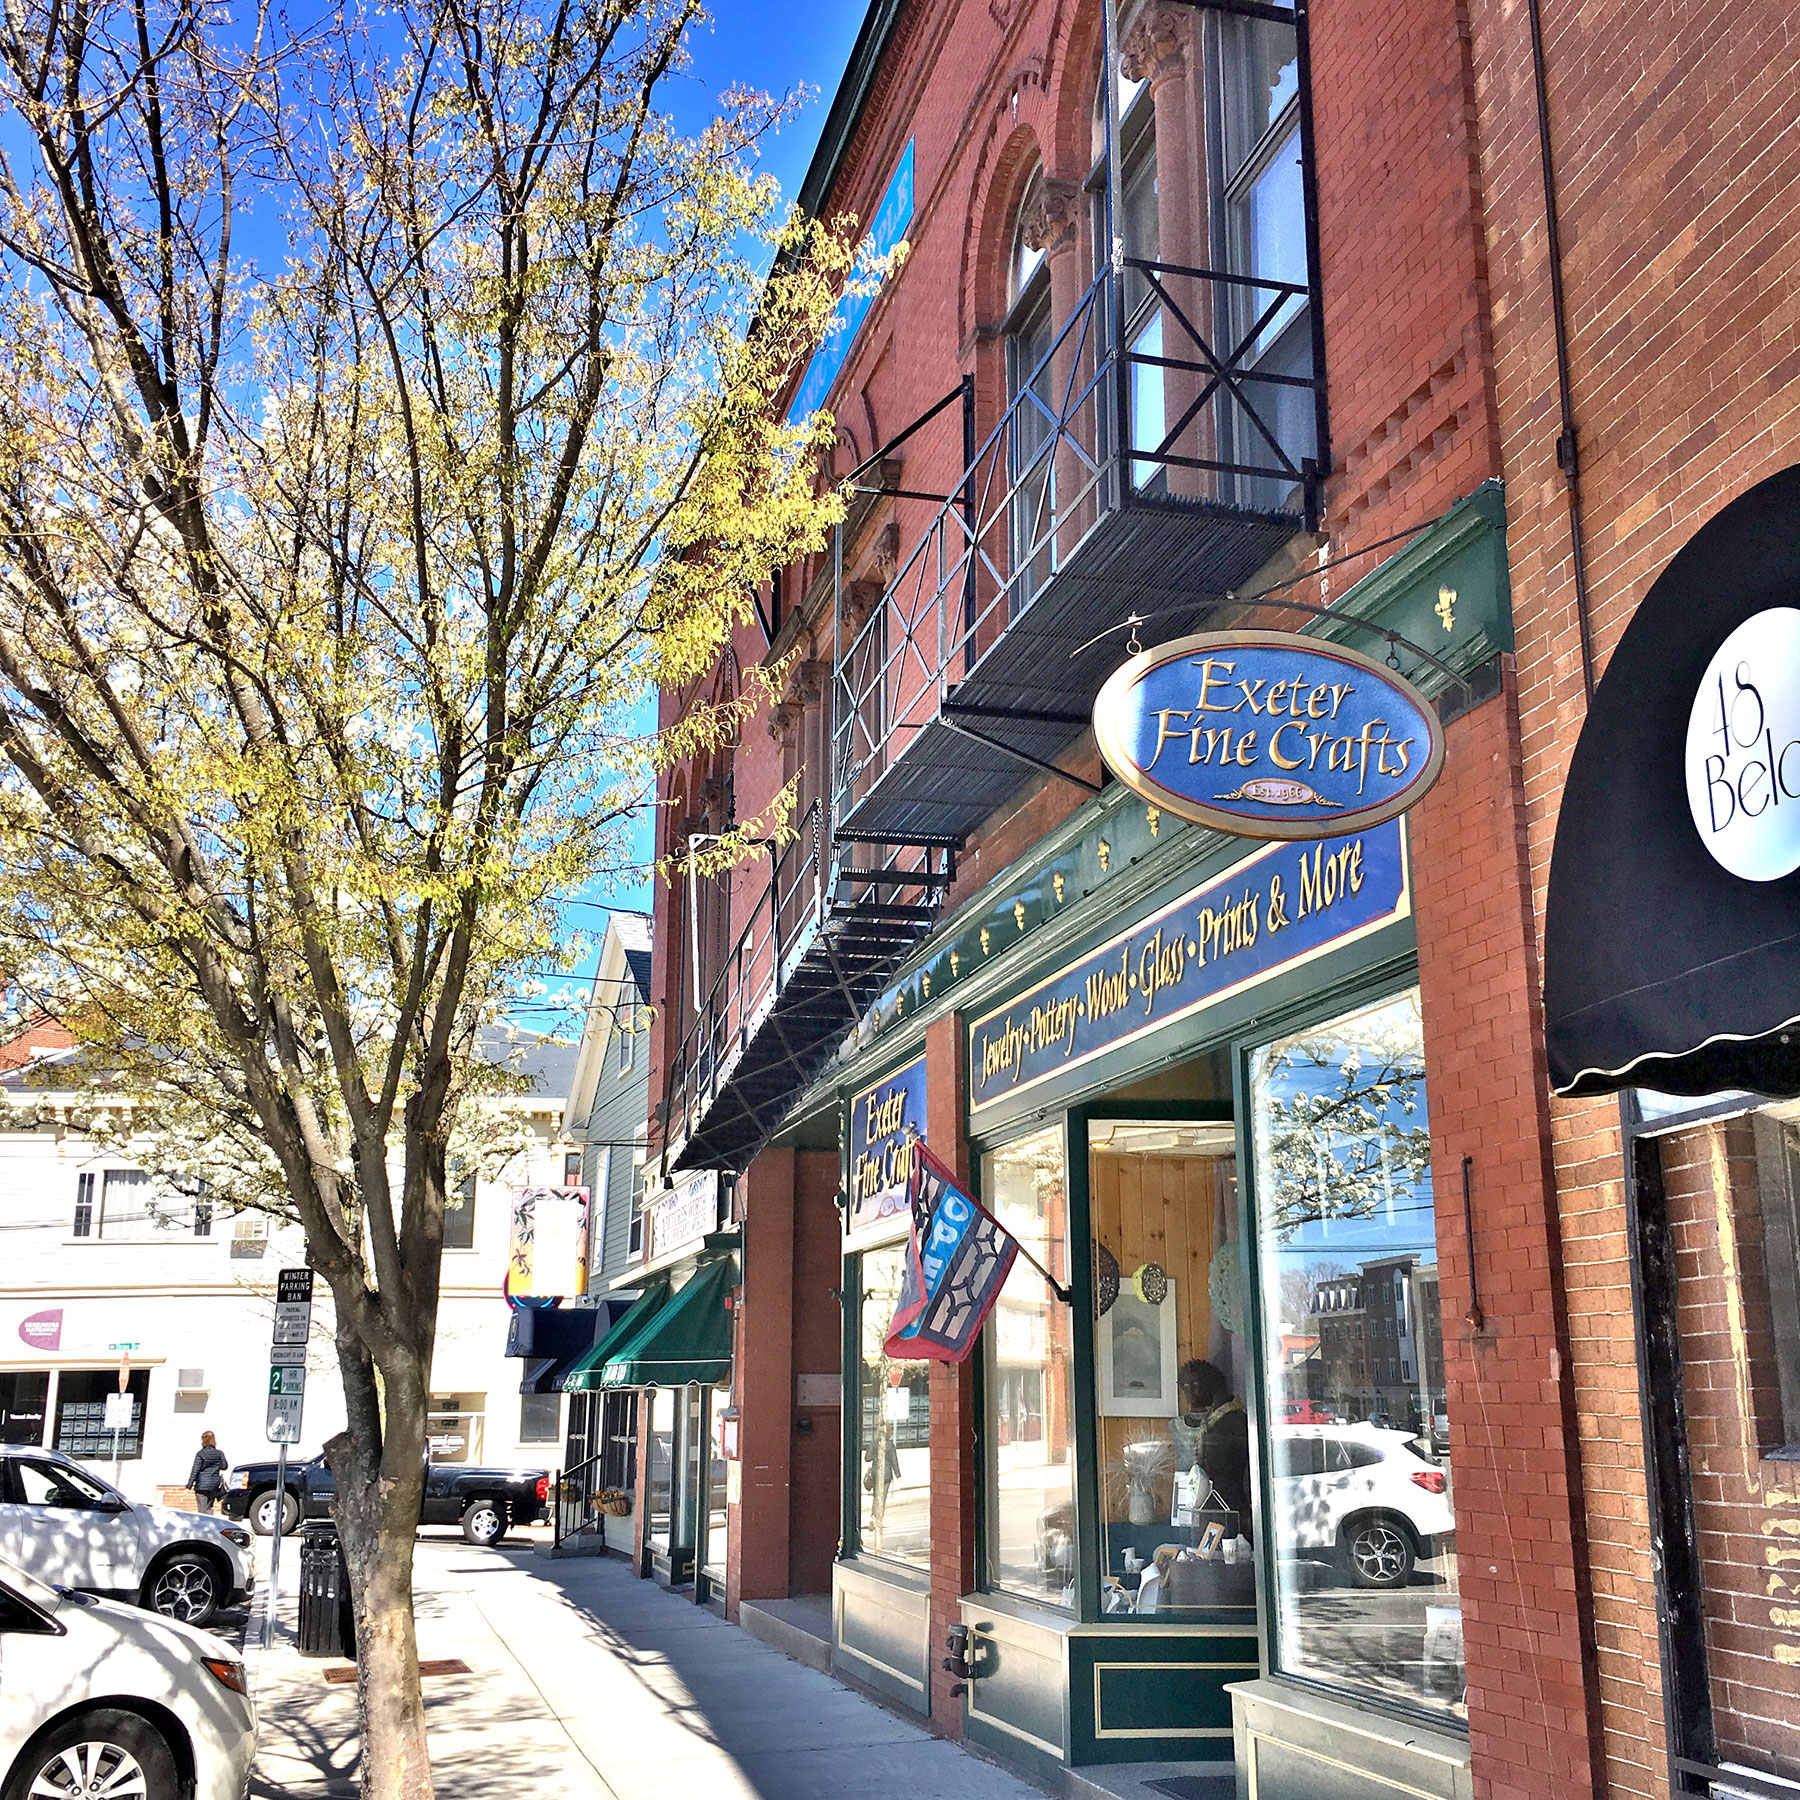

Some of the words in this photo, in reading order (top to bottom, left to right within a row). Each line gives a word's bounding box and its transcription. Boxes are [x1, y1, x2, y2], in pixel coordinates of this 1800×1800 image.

[1191, 658, 1356, 719] Exeter
[1713, 661, 1764, 756] 48
[1145, 708, 1259, 772] Fine
[1268, 718, 1415, 795] Crafts
[1251, 784, 1275, 798] Est.
[1275, 786, 1303, 800] 1966
[1085, 947, 1129, 1025] Wood
[1138, 927, 1186, 1016] Glass
[1198, 888, 1260, 968] Prints
[1267, 874, 1290, 931] &
[1298, 838, 1365, 919] More
[865, 1087, 907, 1145] Exeter
[855, 1151, 881, 1214] Fine
[882, 1138, 917, 1203] Craft
[283, 1271, 309, 1280] WINTER
[280, 1282, 311, 1291] PARKING
[287, 1292, 302, 1301] BAN
[271, 1371, 281, 1390] 2
[289, 1370, 297, 1379] HR
[283, 1382, 302, 1392] PARKING
[274, 1399, 288, 1410] 8:00
[289, 1400, 298, 1410] AM
[281, 1412, 289, 1422] TO
